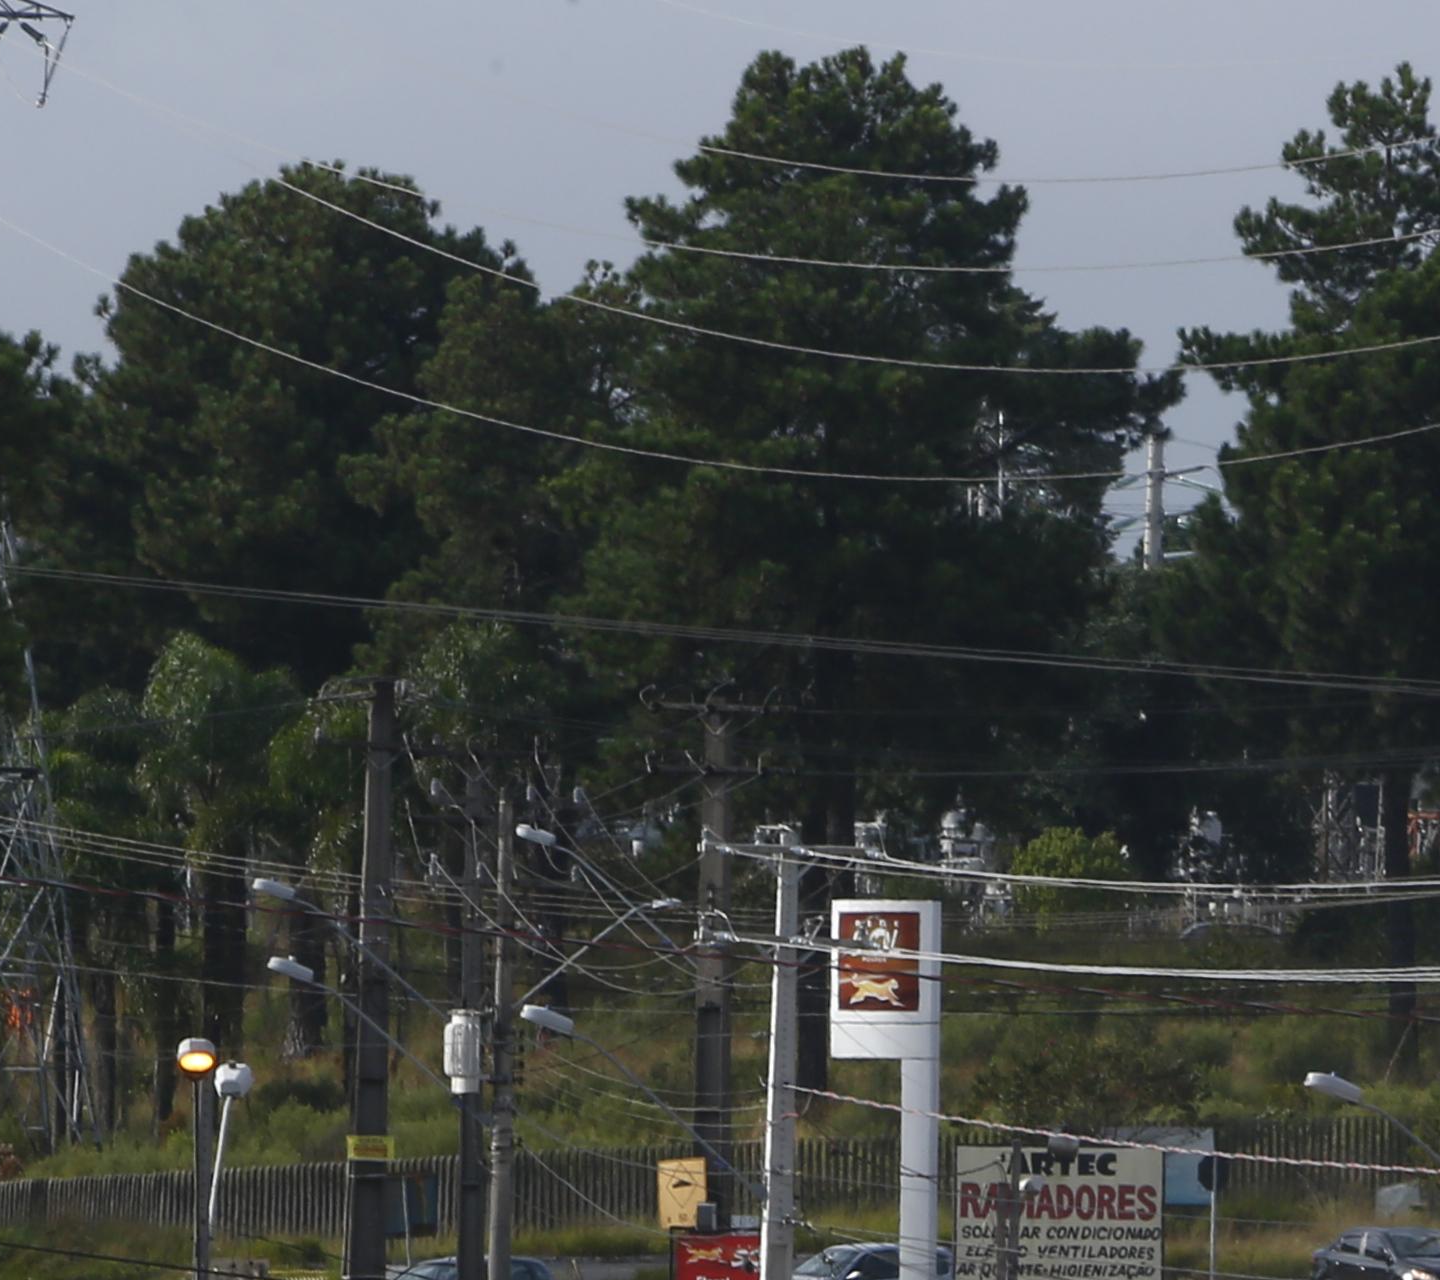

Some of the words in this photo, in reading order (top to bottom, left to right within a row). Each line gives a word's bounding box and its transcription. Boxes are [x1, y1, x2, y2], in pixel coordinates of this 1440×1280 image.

[961, 1182, 1157, 1221] RAIADORES
[1021, 1227, 1040, 1239] AR
[1046, 1227, 1160, 1240] CONDICIONADO
[1037, 1246, 1154, 1260] VENTILADORES
[957, 1263, 976, 1276] AR
